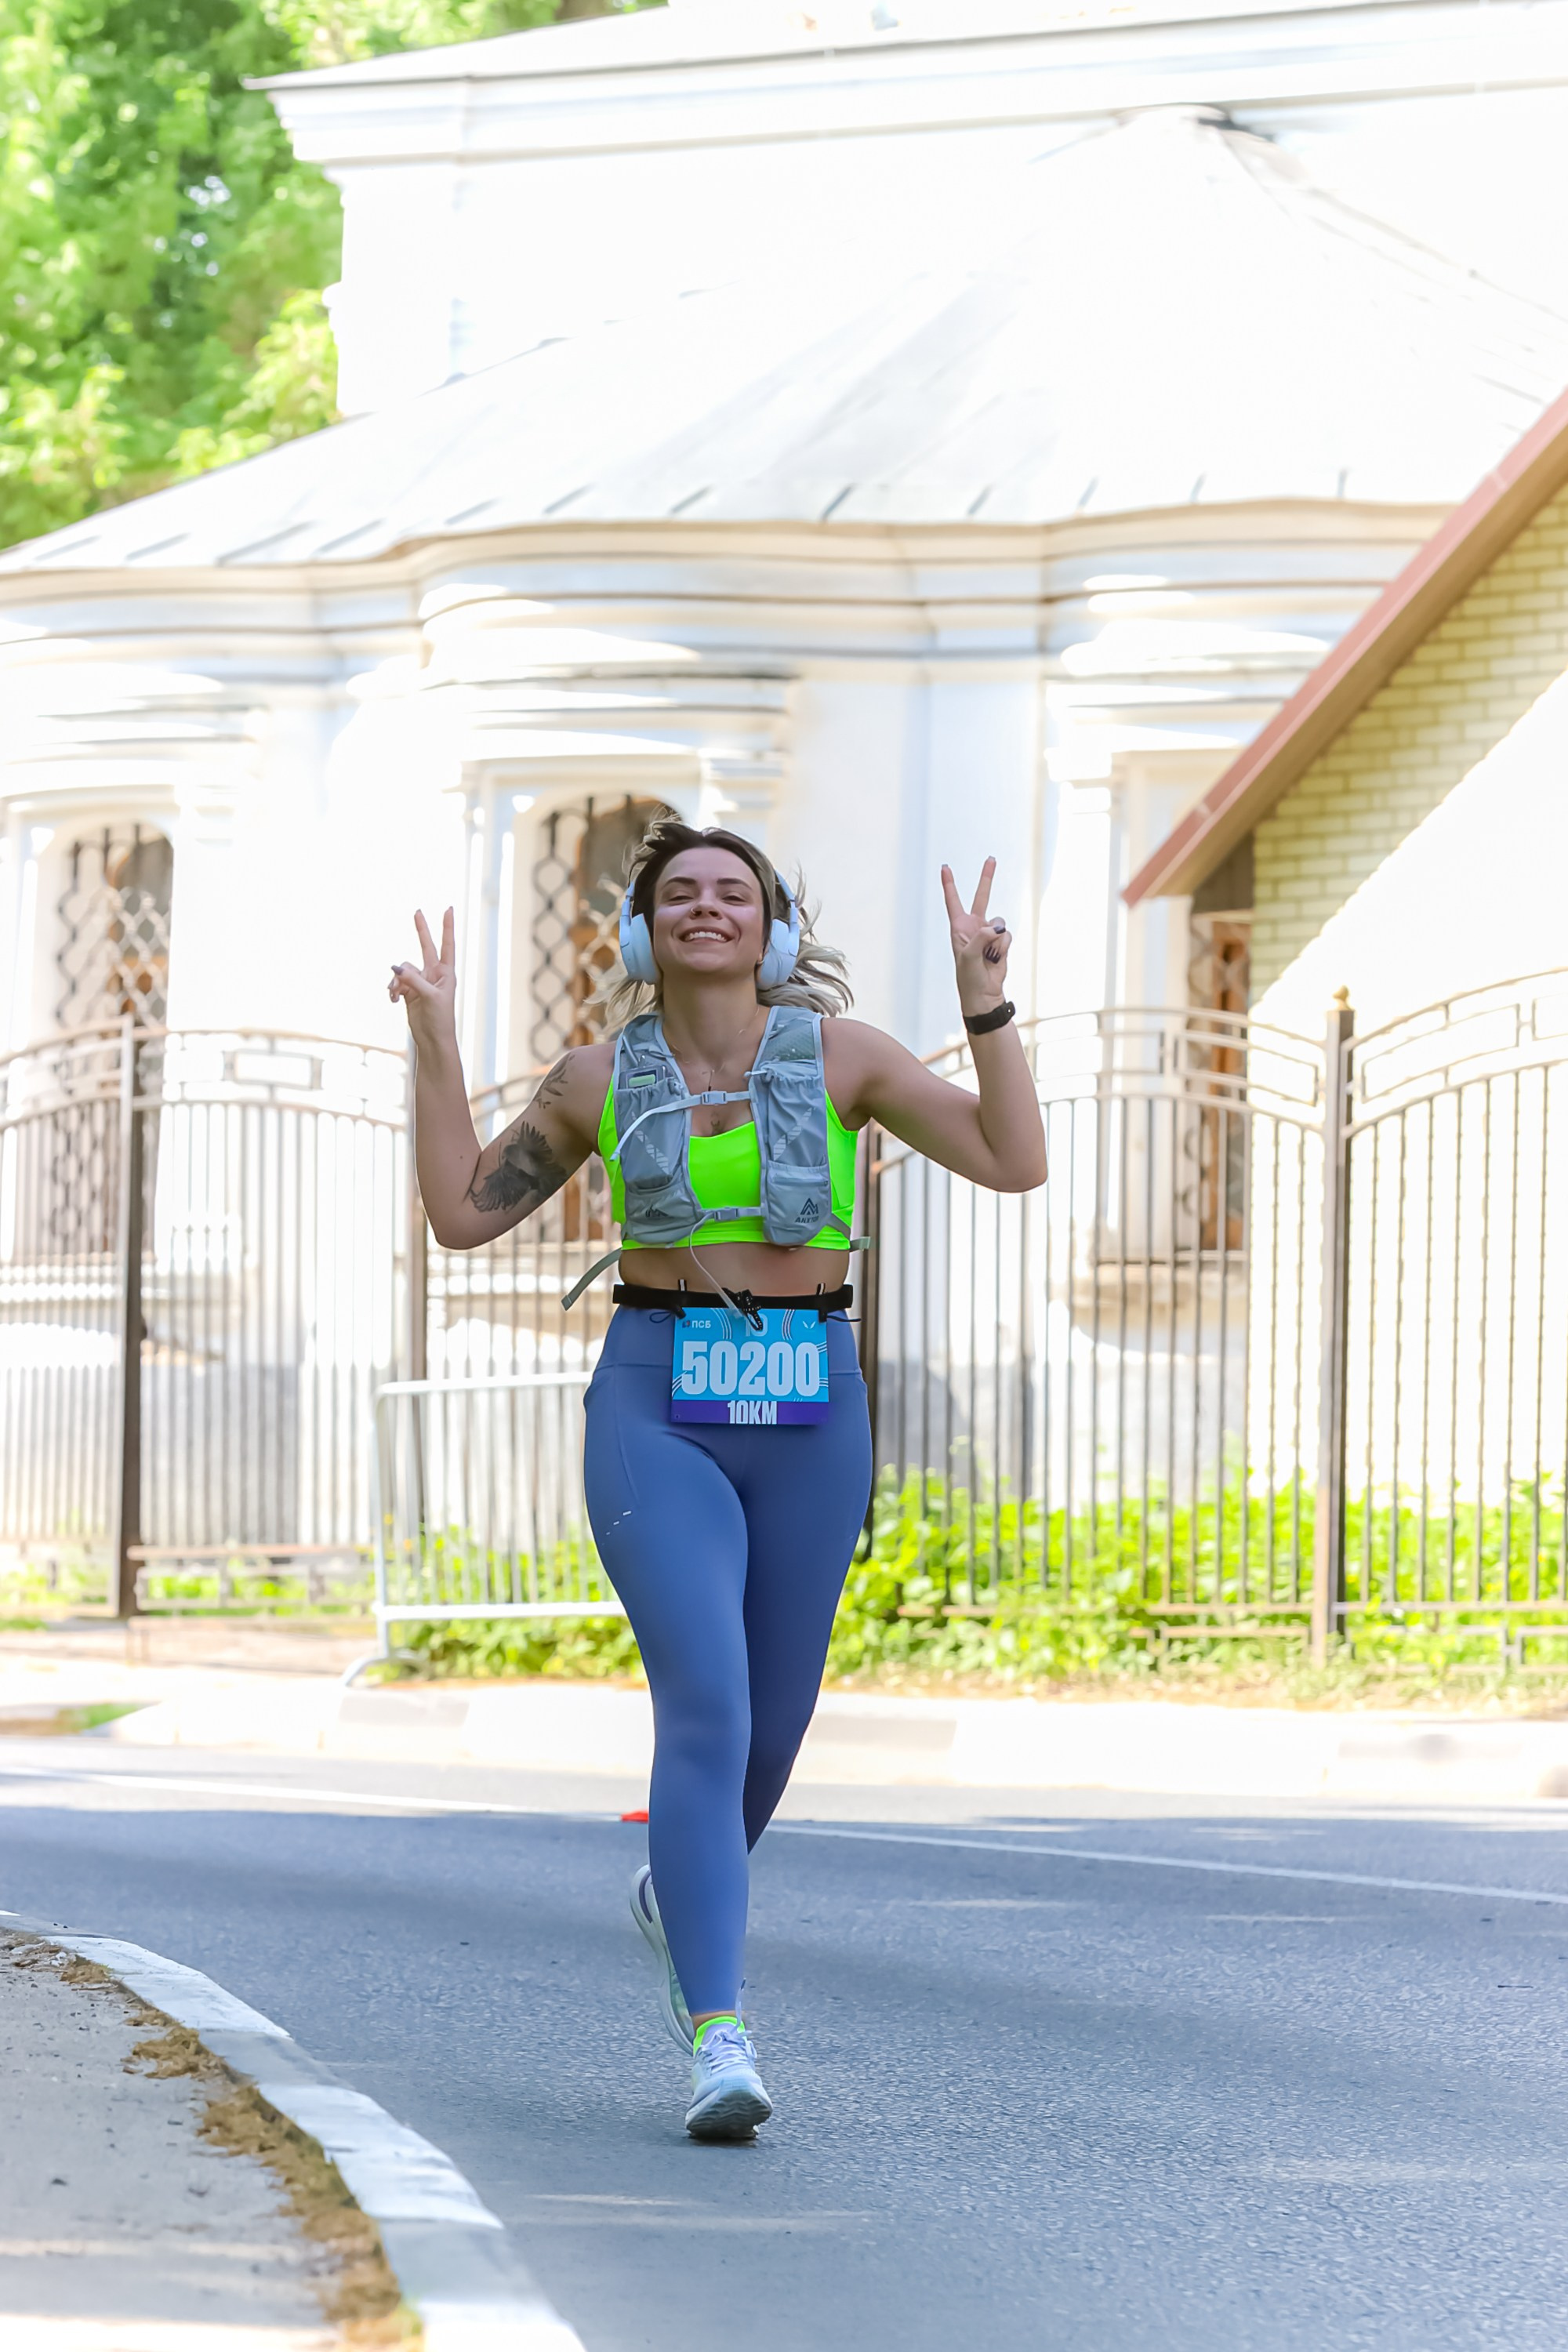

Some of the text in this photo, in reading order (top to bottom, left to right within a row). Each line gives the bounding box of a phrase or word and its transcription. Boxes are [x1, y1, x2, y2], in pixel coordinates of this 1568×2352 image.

[691, 1320, 712, 1329] ПСБ
[681, 1341, 820, 1396] 50200
[727, 1400, 778, 1425] 10KM
